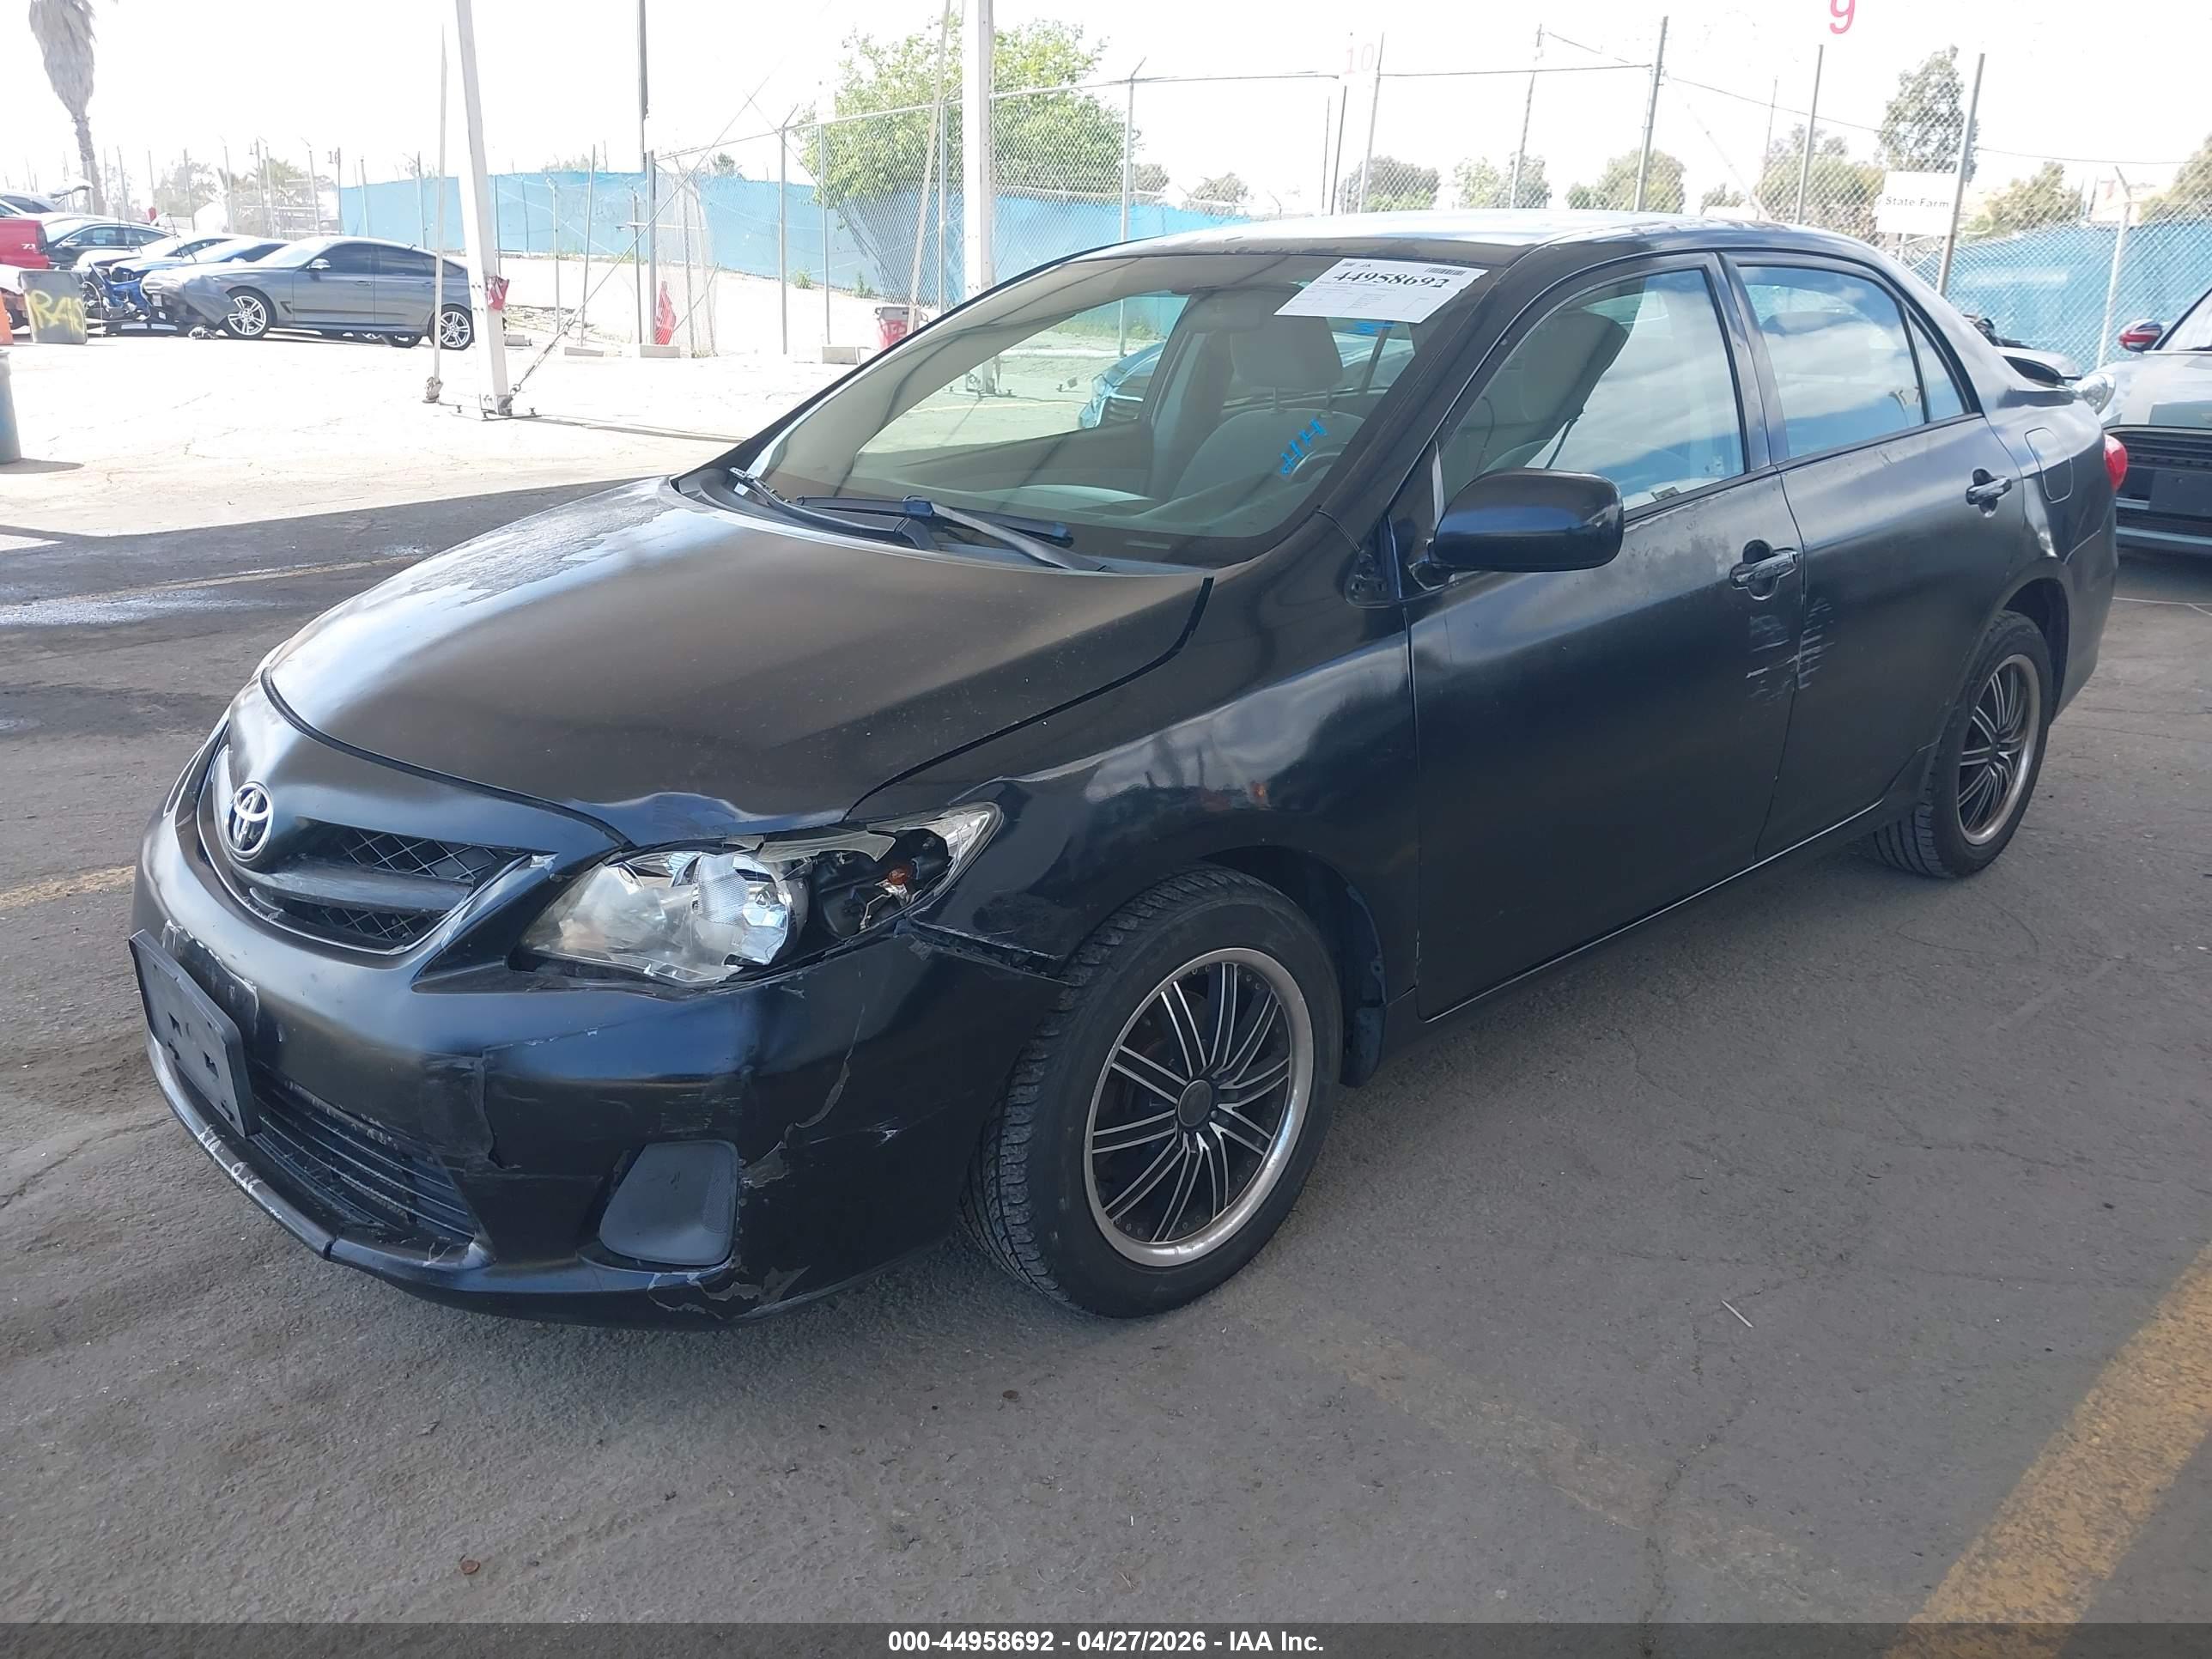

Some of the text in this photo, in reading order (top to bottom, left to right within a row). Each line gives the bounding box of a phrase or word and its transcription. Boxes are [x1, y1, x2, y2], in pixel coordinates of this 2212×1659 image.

[1885, 195, 1950, 208] State Farm
[1333, 270, 1450, 289] 44958692
